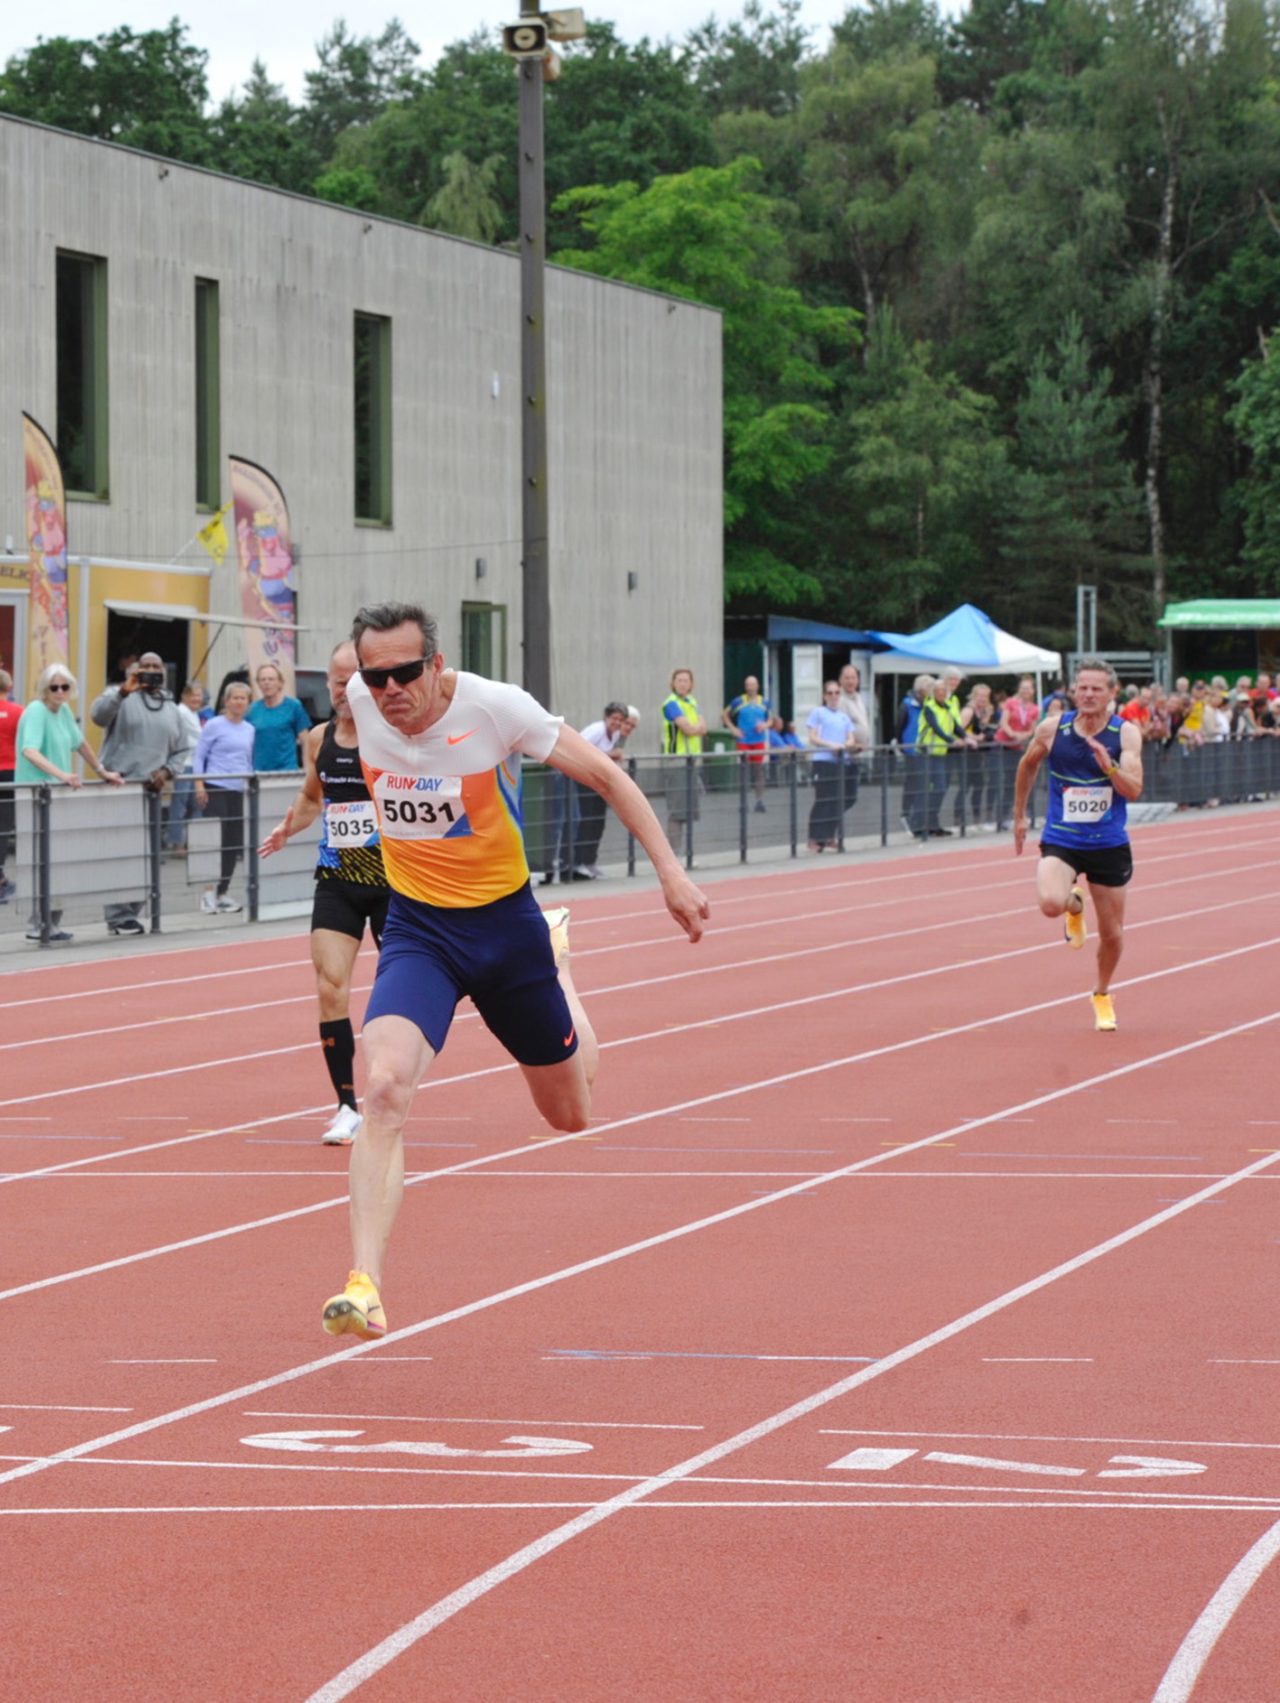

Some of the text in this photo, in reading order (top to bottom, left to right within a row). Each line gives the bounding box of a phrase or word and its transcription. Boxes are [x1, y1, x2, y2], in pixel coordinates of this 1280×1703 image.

[383, 799, 455, 824] 5031
[1068, 800, 1108, 813] 5020
[330, 818, 374, 837] 5035
